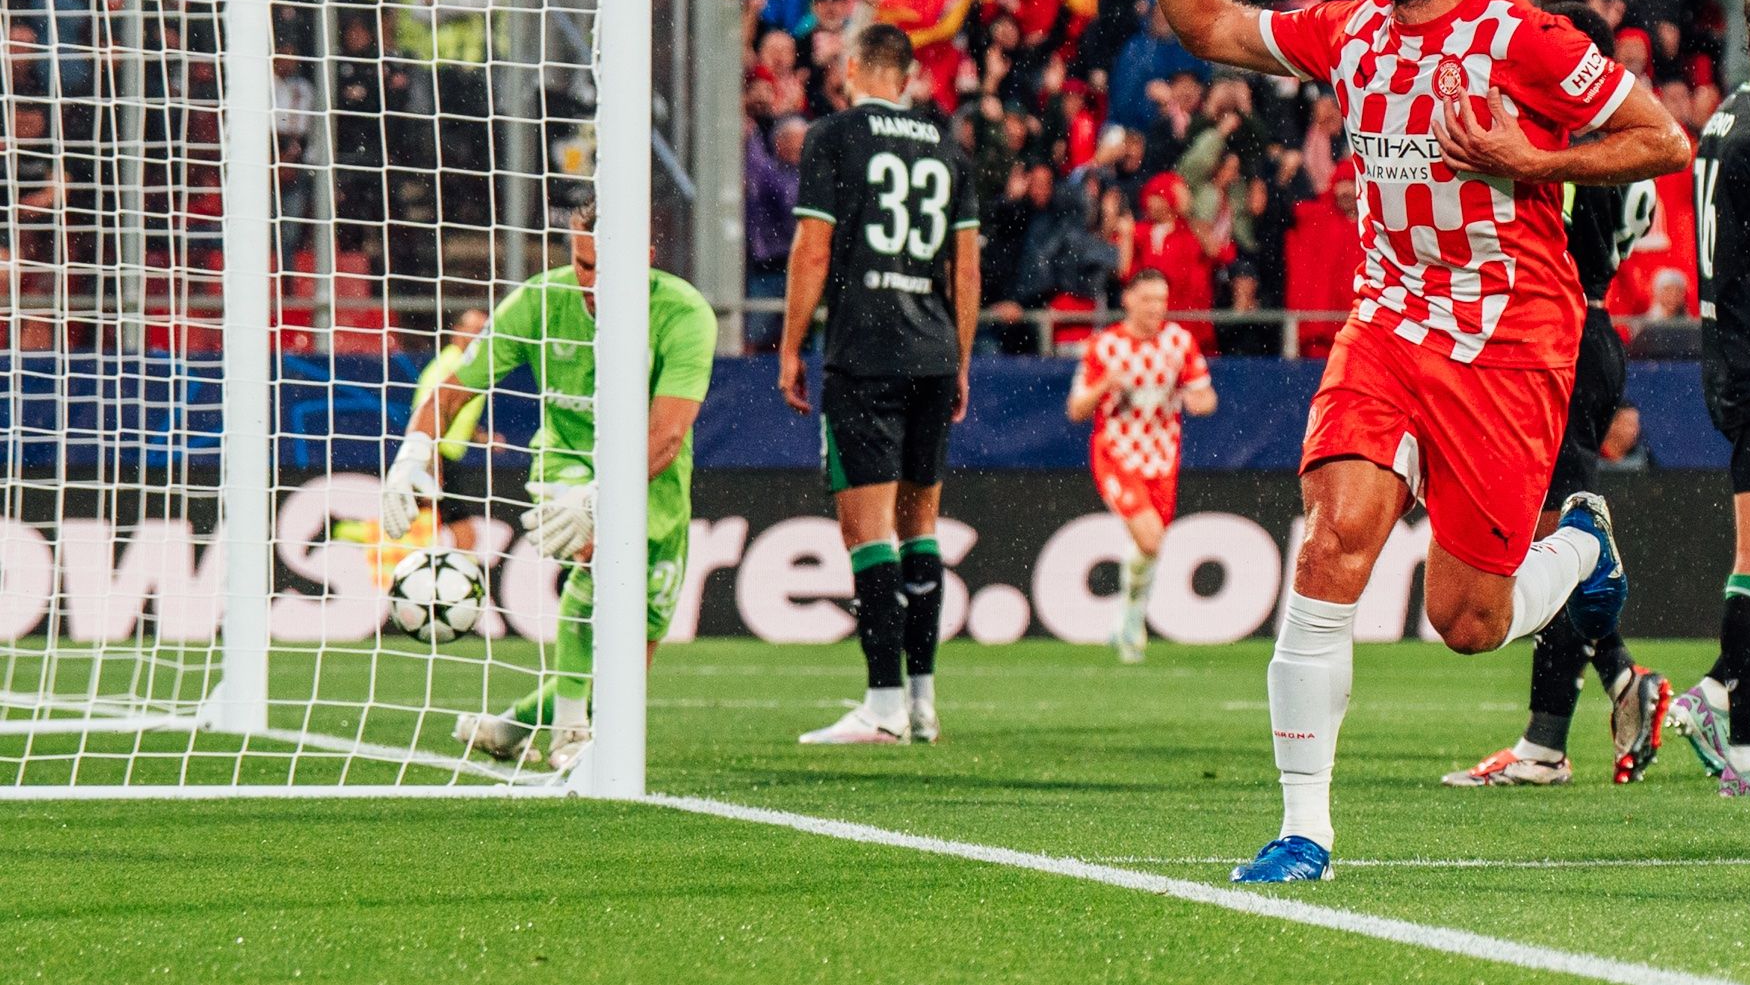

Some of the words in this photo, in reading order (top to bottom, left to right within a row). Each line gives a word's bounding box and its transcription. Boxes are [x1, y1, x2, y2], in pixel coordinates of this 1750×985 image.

[868, 115, 940, 144] HANCKO
[1351, 133, 1442, 158] ETIHAD
[1366, 165, 1428, 179] AIRWAYS
[866, 150, 950, 260] 33
[1694, 156, 1719, 279] 16
